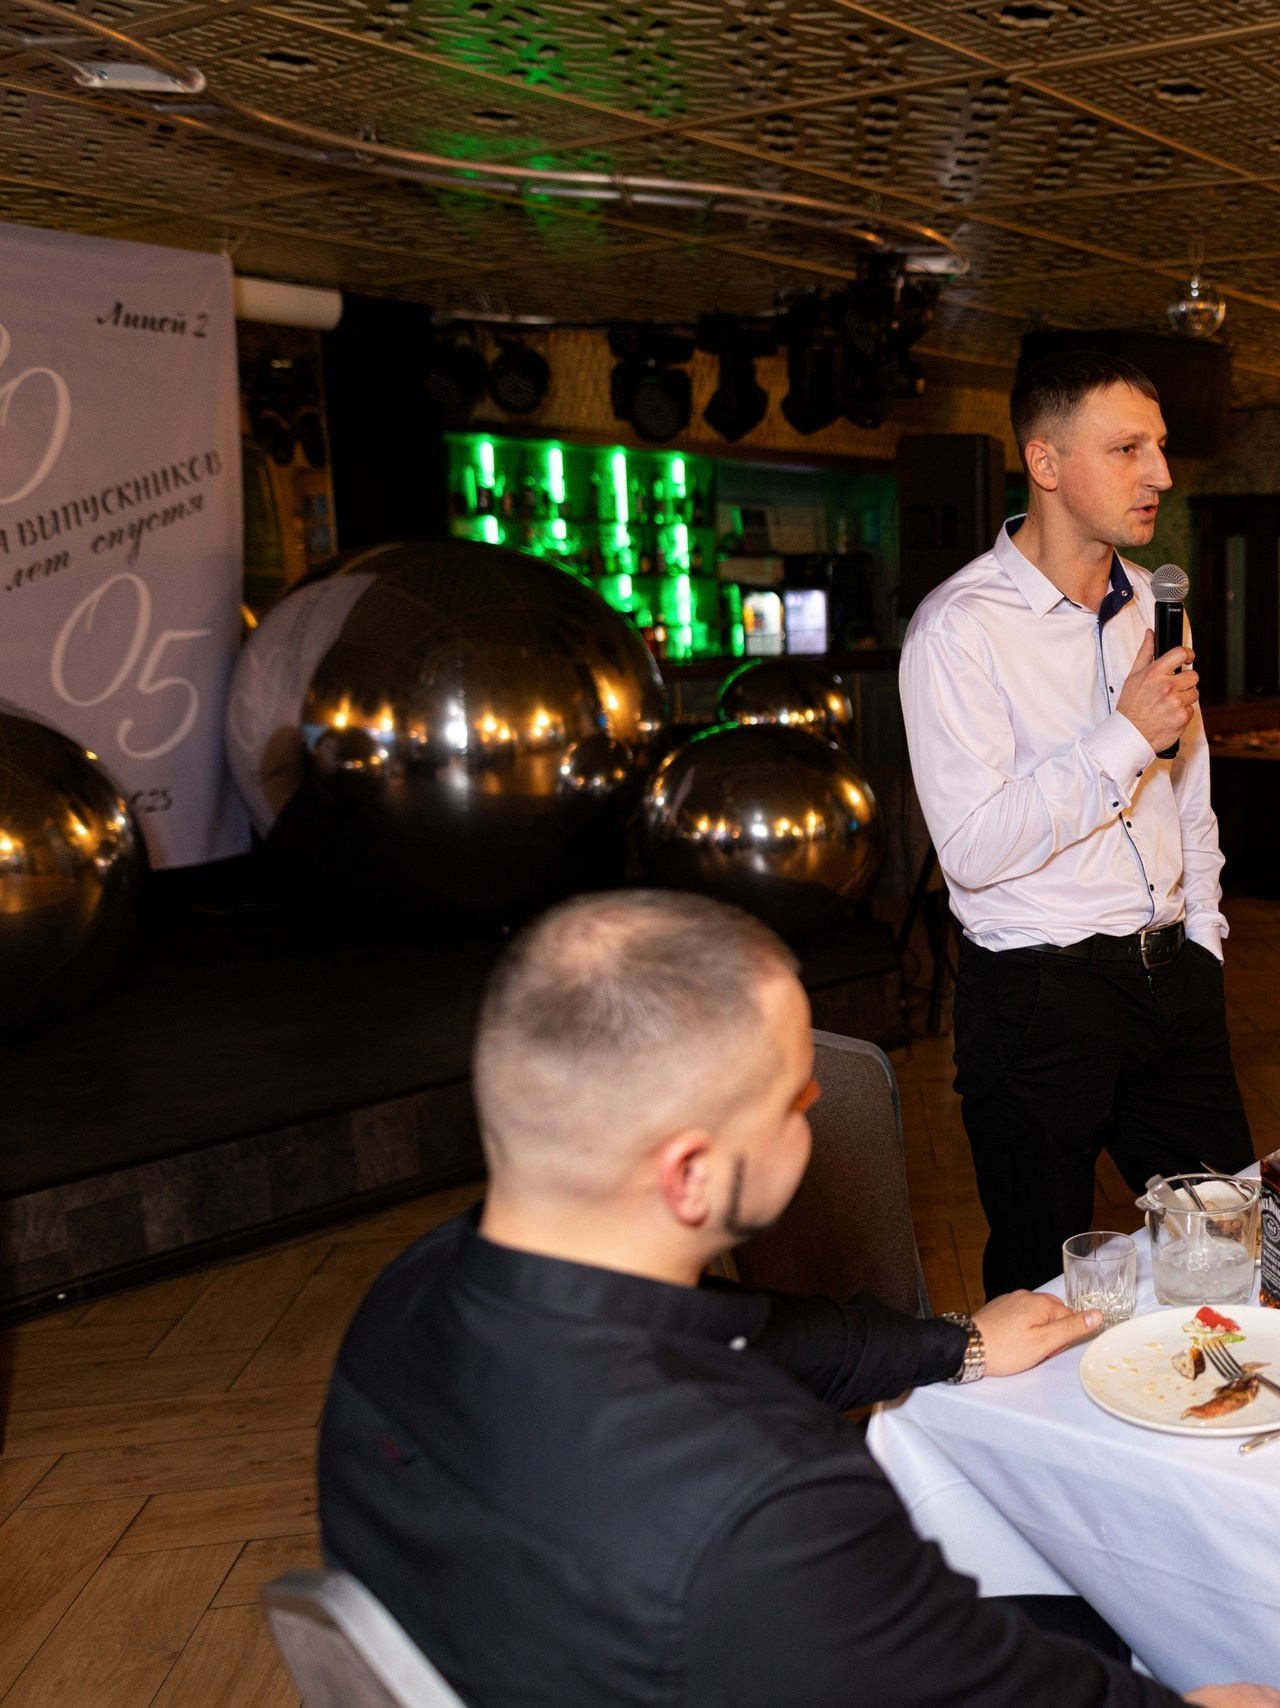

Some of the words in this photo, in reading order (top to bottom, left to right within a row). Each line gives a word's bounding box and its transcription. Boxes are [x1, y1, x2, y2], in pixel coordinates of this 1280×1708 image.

[193, 311, 210, 338] 2
[4, 549, 71, 593] лет
[91, 493, 205, 566] спустя
[17, 448, 223, 547] ВЫПУСКНИКОВ
[50, 571, 213, 761] 05
